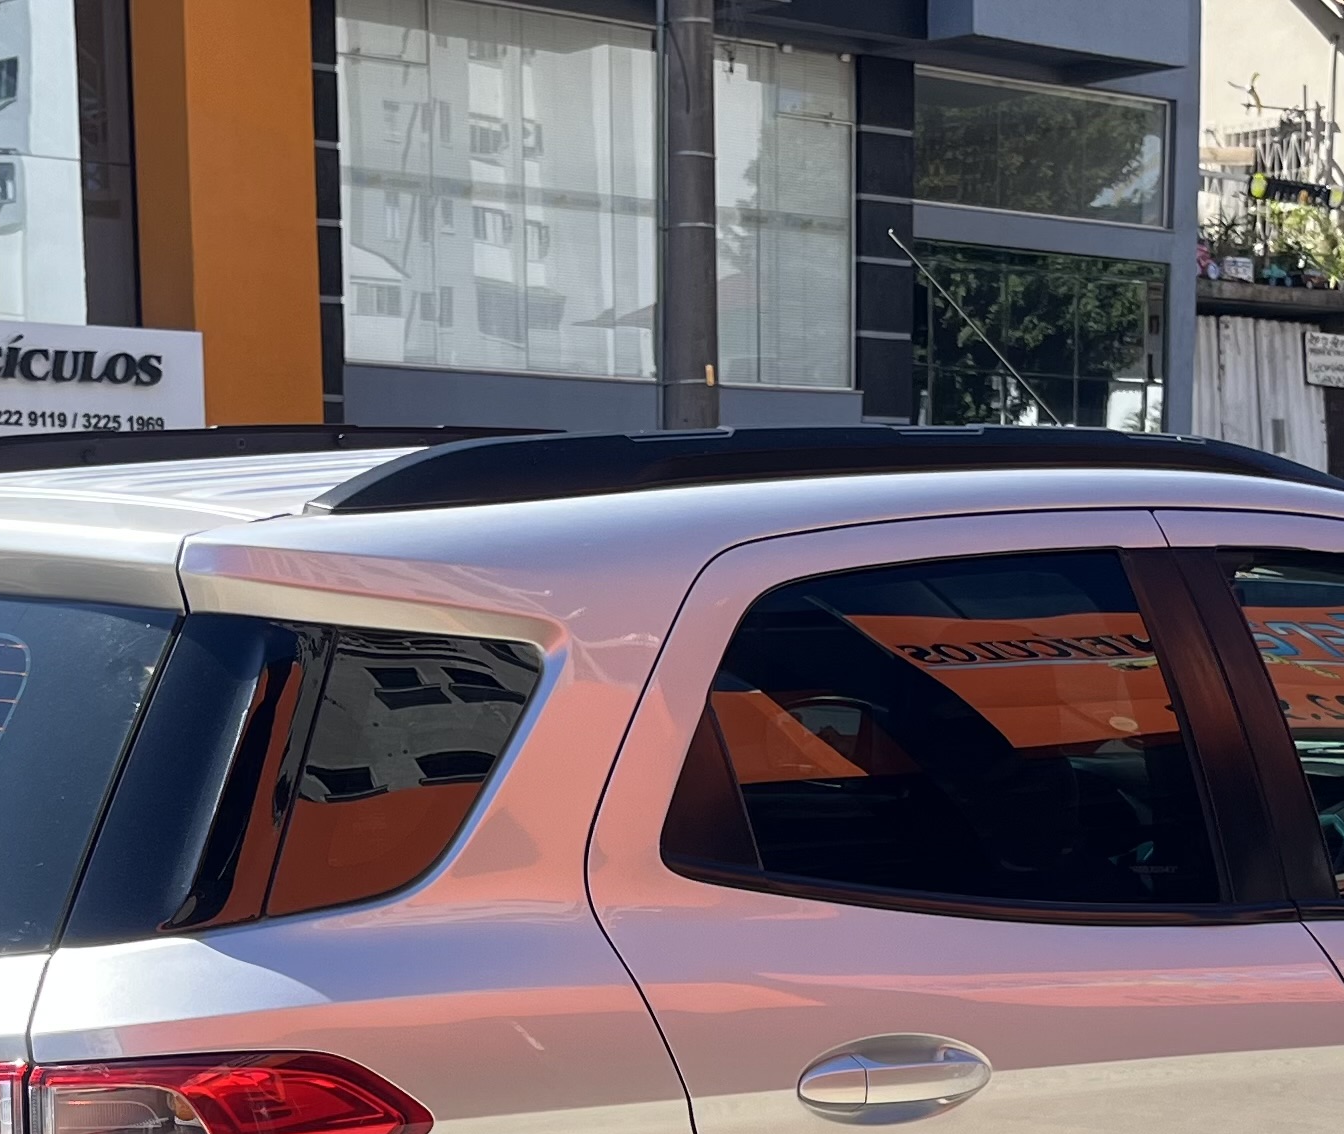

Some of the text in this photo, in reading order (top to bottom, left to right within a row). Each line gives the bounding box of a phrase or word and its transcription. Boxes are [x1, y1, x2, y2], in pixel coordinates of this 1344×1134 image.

[27, 411, 67, 429] 9119
[82, 412, 122, 431] 3225
[126, 415, 165, 432] 1969
